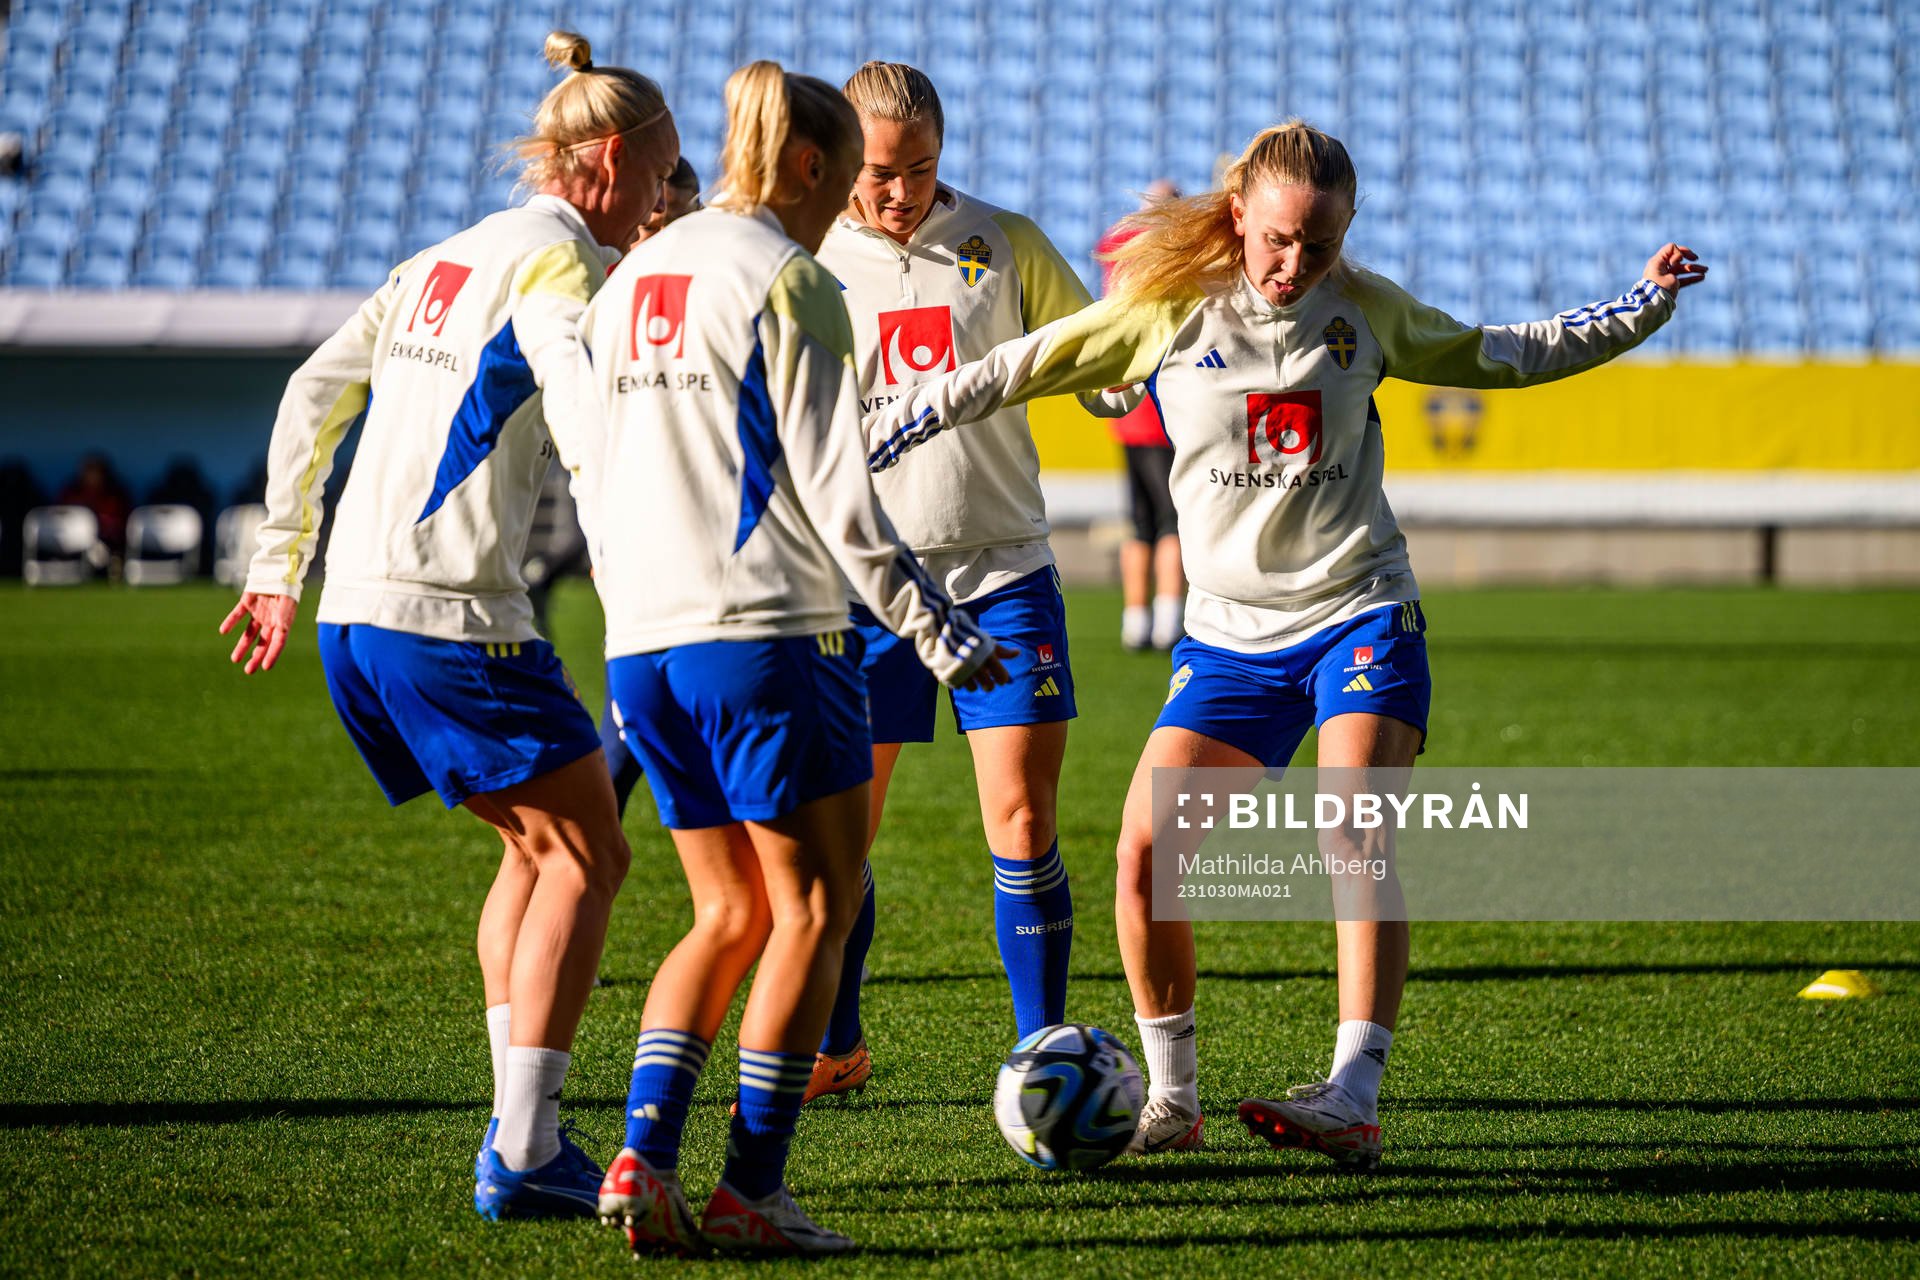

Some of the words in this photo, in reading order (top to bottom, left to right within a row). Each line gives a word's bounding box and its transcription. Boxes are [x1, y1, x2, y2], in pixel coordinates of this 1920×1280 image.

[425, 348, 458, 372] SPEL
[1210, 468, 1302, 489] SVENSKA
[1309, 464, 1349, 486] SPEL
